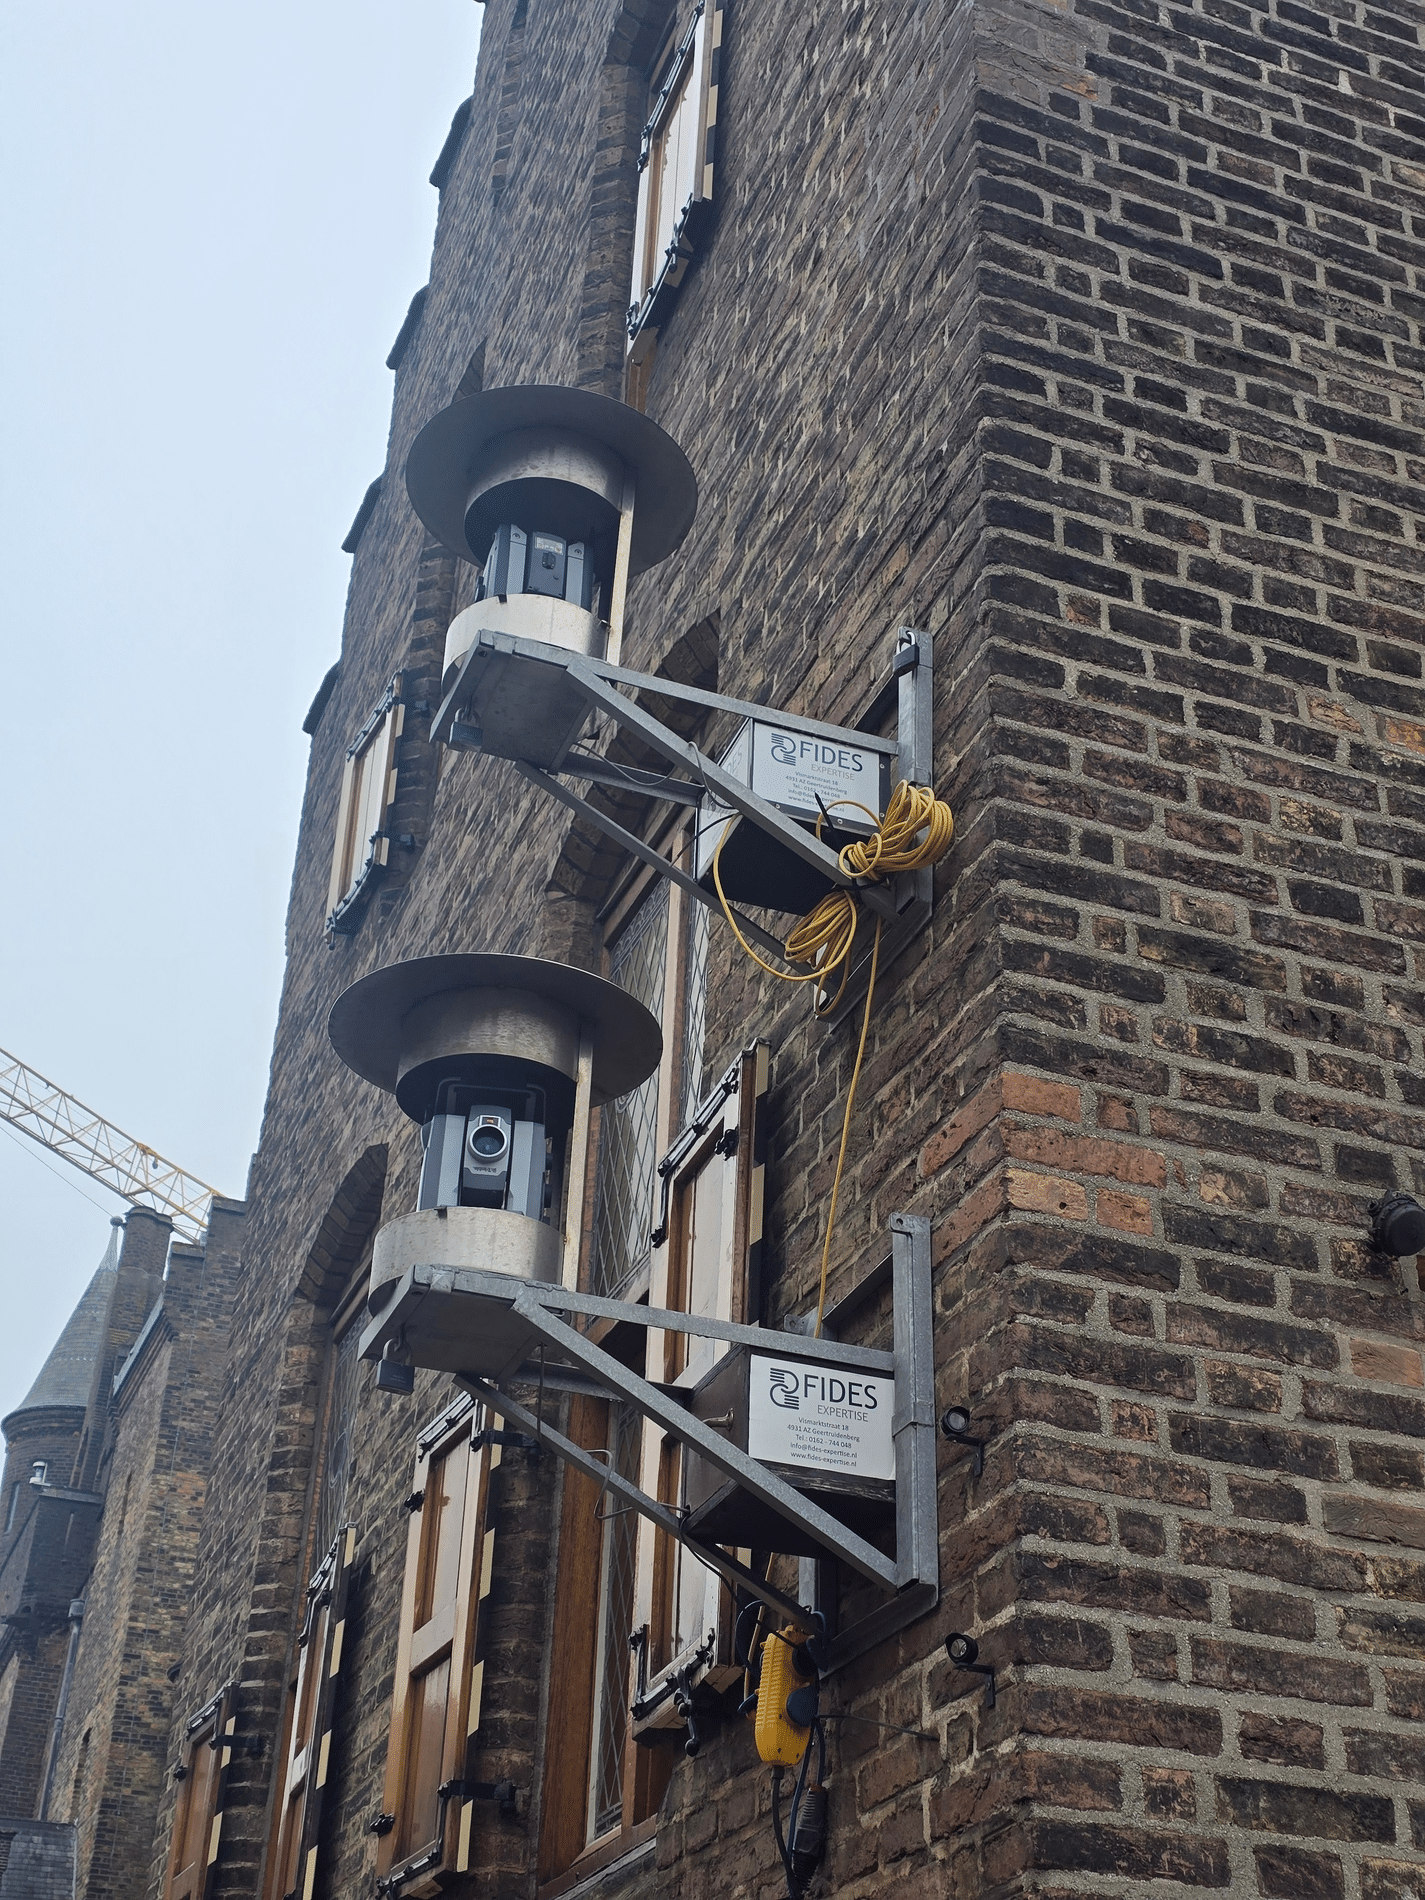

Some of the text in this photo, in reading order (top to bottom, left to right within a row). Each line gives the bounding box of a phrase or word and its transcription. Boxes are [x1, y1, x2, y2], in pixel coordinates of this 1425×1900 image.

[800, 740, 863, 772] FIDES
[795, 771, 831, 784] Vismarktstraat
[811, 764, 855, 781] EXPERTISE
[806, 780, 848, 795] Geertruidenberg
[804, 1373, 878, 1410] FIDES
[817, 1404, 869, 1423] EXPERTISE
[798, 1417, 841, 1430] Vismarktstraat
[787, 1423, 802, 1432] 4931
[812, 1428, 860, 1442] Geertruidenberg
[808, 1436, 824, 1445] 0162
[790, 1442, 857, 1459] info@fides-expertise.nl
[790, 1452, 857, 1467] www.fides-expertise.nl
